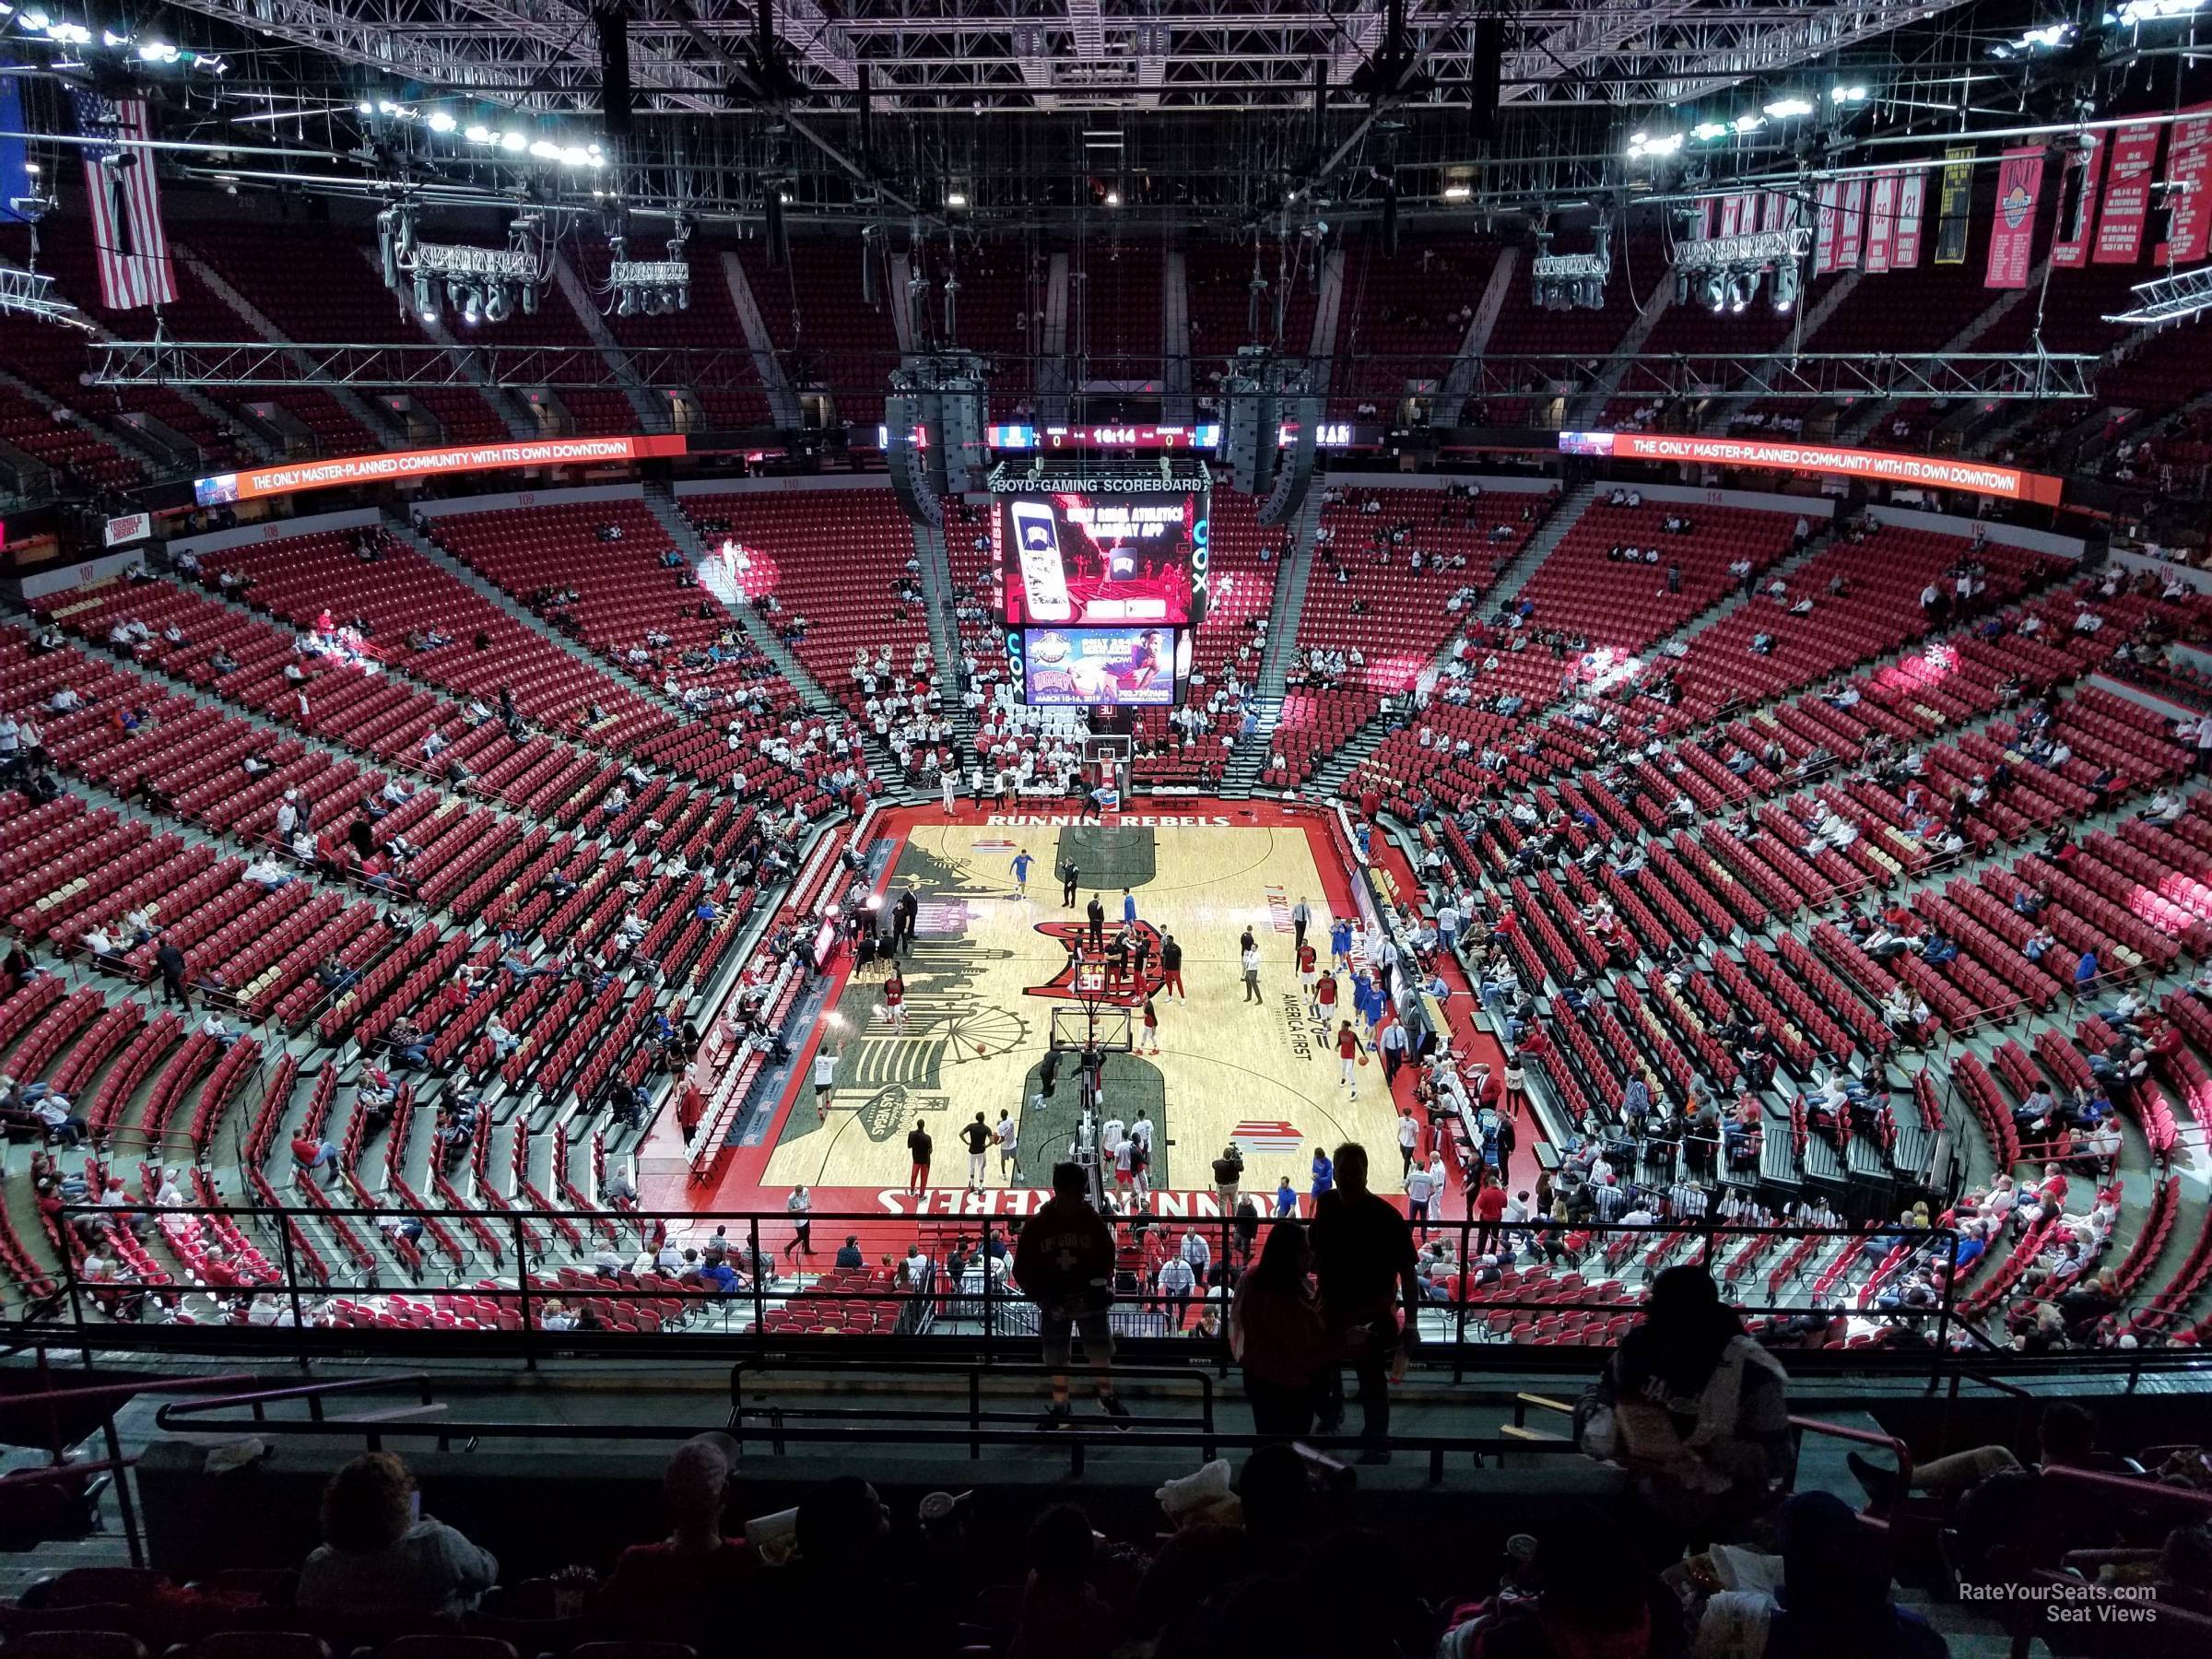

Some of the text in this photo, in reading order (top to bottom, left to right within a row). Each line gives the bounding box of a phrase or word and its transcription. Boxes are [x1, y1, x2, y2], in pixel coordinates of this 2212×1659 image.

[1849, 200, 1856, 221] 4
[1905, 194, 1917, 218] 21
[1820, 208, 1833, 229] 32
[1053, 435, 1061, 447] 0
[1094, 429, 1135, 443] 16:14
[1165, 435, 1173, 447] 0
[252, 441, 627, 490] THE ONLY MASTER-PLANNED COMMUNITY WITH ITS OWN DOWNTOWN
[1634, 440, 2016, 491] THE ONLY MASTER-PLANNED COMMUNITY WITH ITS OWN DOWNTOWN
[782, 478, 798, 488] 110
[997, 479, 1202, 492] BOYD GAMING SCOREBOARD
[518, 493, 535, 505] 109
[1707, 491, 1723, 502] 114
[1131, 507, 1183, 522] ATHLETICS
[264, 525, 278, 539] 108
[1142, 523, 1164, 537] APP
[992, 501, 1004, 608] BE A REBEL.
[1193, 520, 1207, 593] COX
[79, 565, 94, 582] 107
[1007, 633, 1024, 696] COX
[1032, 671, 1072, 691] UNLV
[1119, 816, 1231, 827] REBELS
[1080, 964, 1105, 974] 16:14
[1082, 974, 1101, 990] 30
[1281, 994, 1312, 1061] AMERICA FIRST
[871, 1092, 896, 1135] LAS VEGAS
